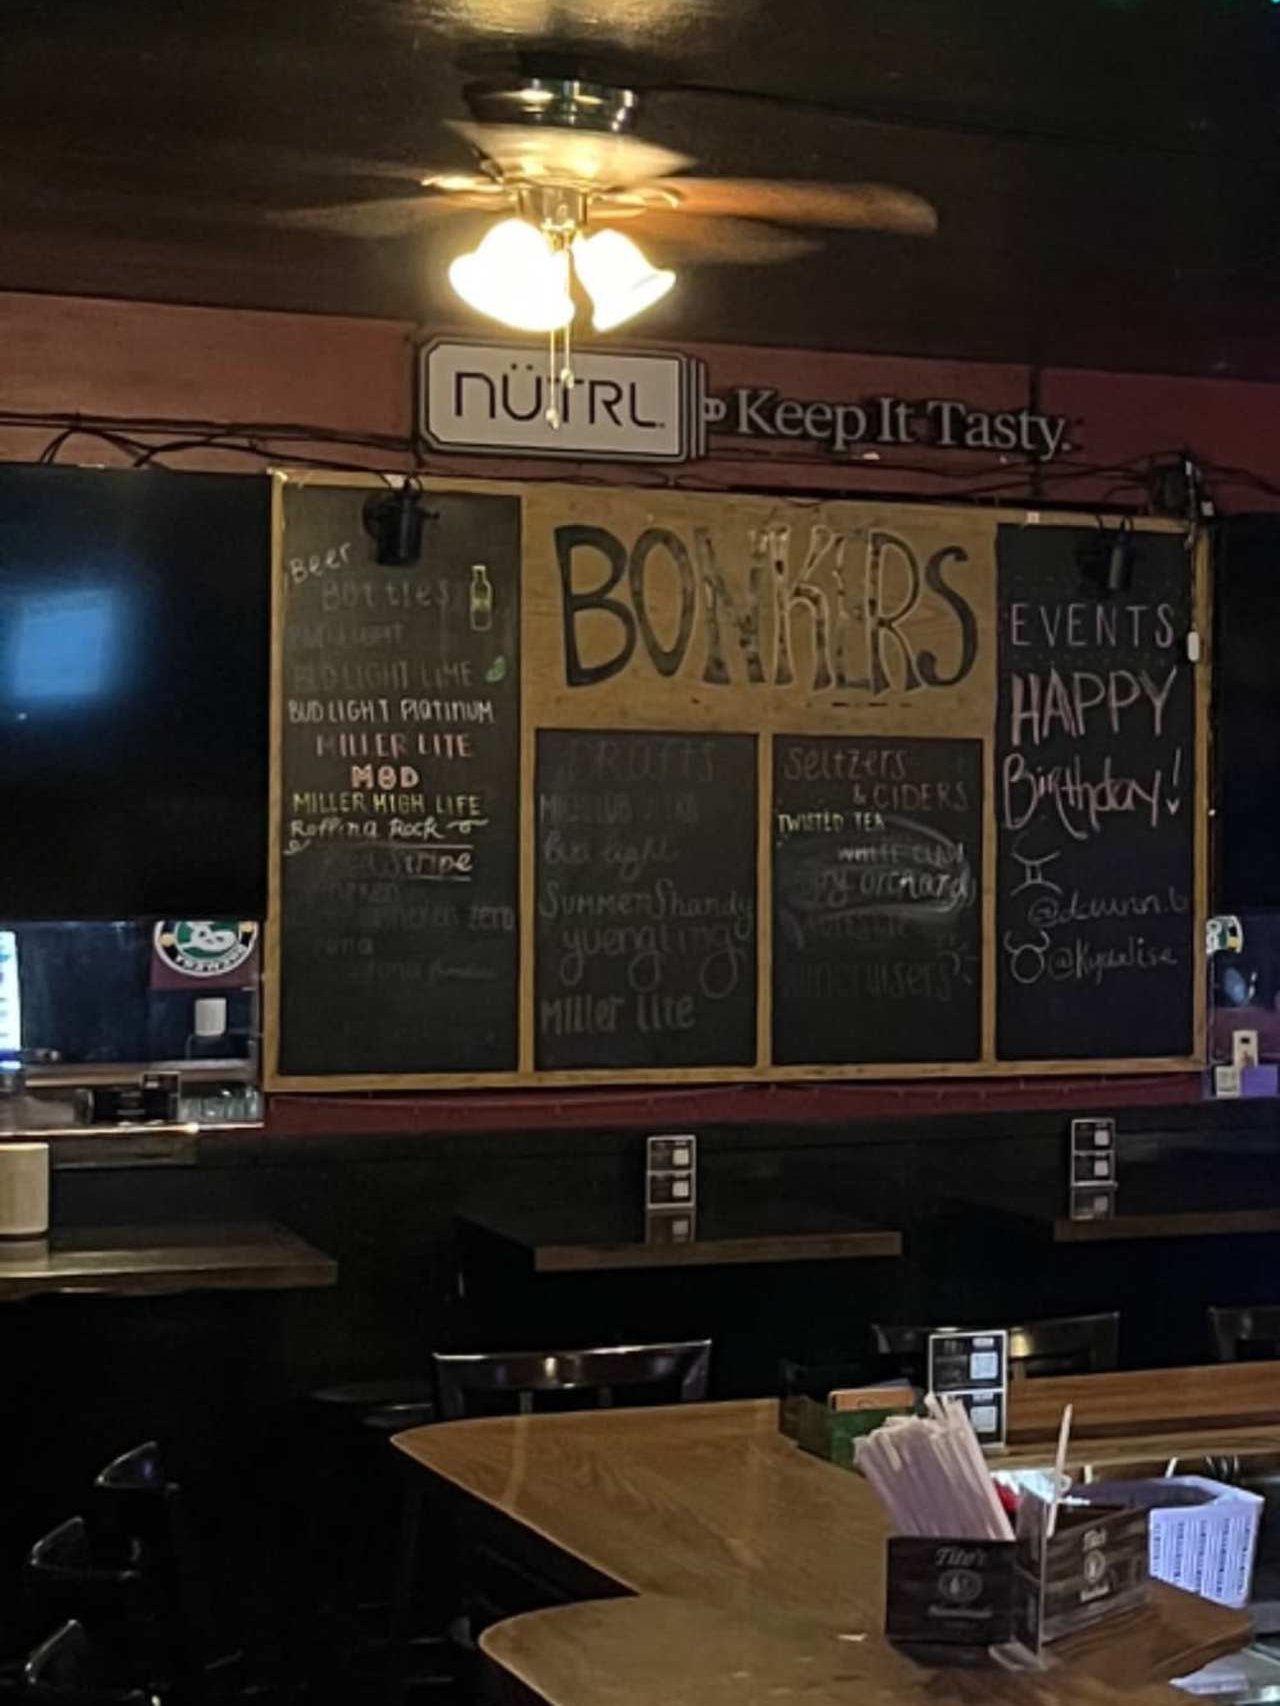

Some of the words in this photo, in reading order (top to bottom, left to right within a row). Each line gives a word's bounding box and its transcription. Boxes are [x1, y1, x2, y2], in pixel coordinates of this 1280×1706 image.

[735, 389, 867, 444] Keep
[876, 394, 917, 443] It
[925, 400, 1074, 461] Tasty.
[1010, 602, 1176, 649] EVENTS
[288, 698, 324, 724] BUD
[327, 698, 390, 724] LIGHT
[1010, 665, 1178, 746] HAPPY
[316, 733, 409, 760] MILLER
[417, 733, 476, 760] LITE
[291, 791, 368, 814] MILLER
[372, 792, 427, 814] HIGH
[435, 792, 483, 816] LIFE
[873, 781, 970, 812] CIDERS
[388, 815, 448, 842] Rock
